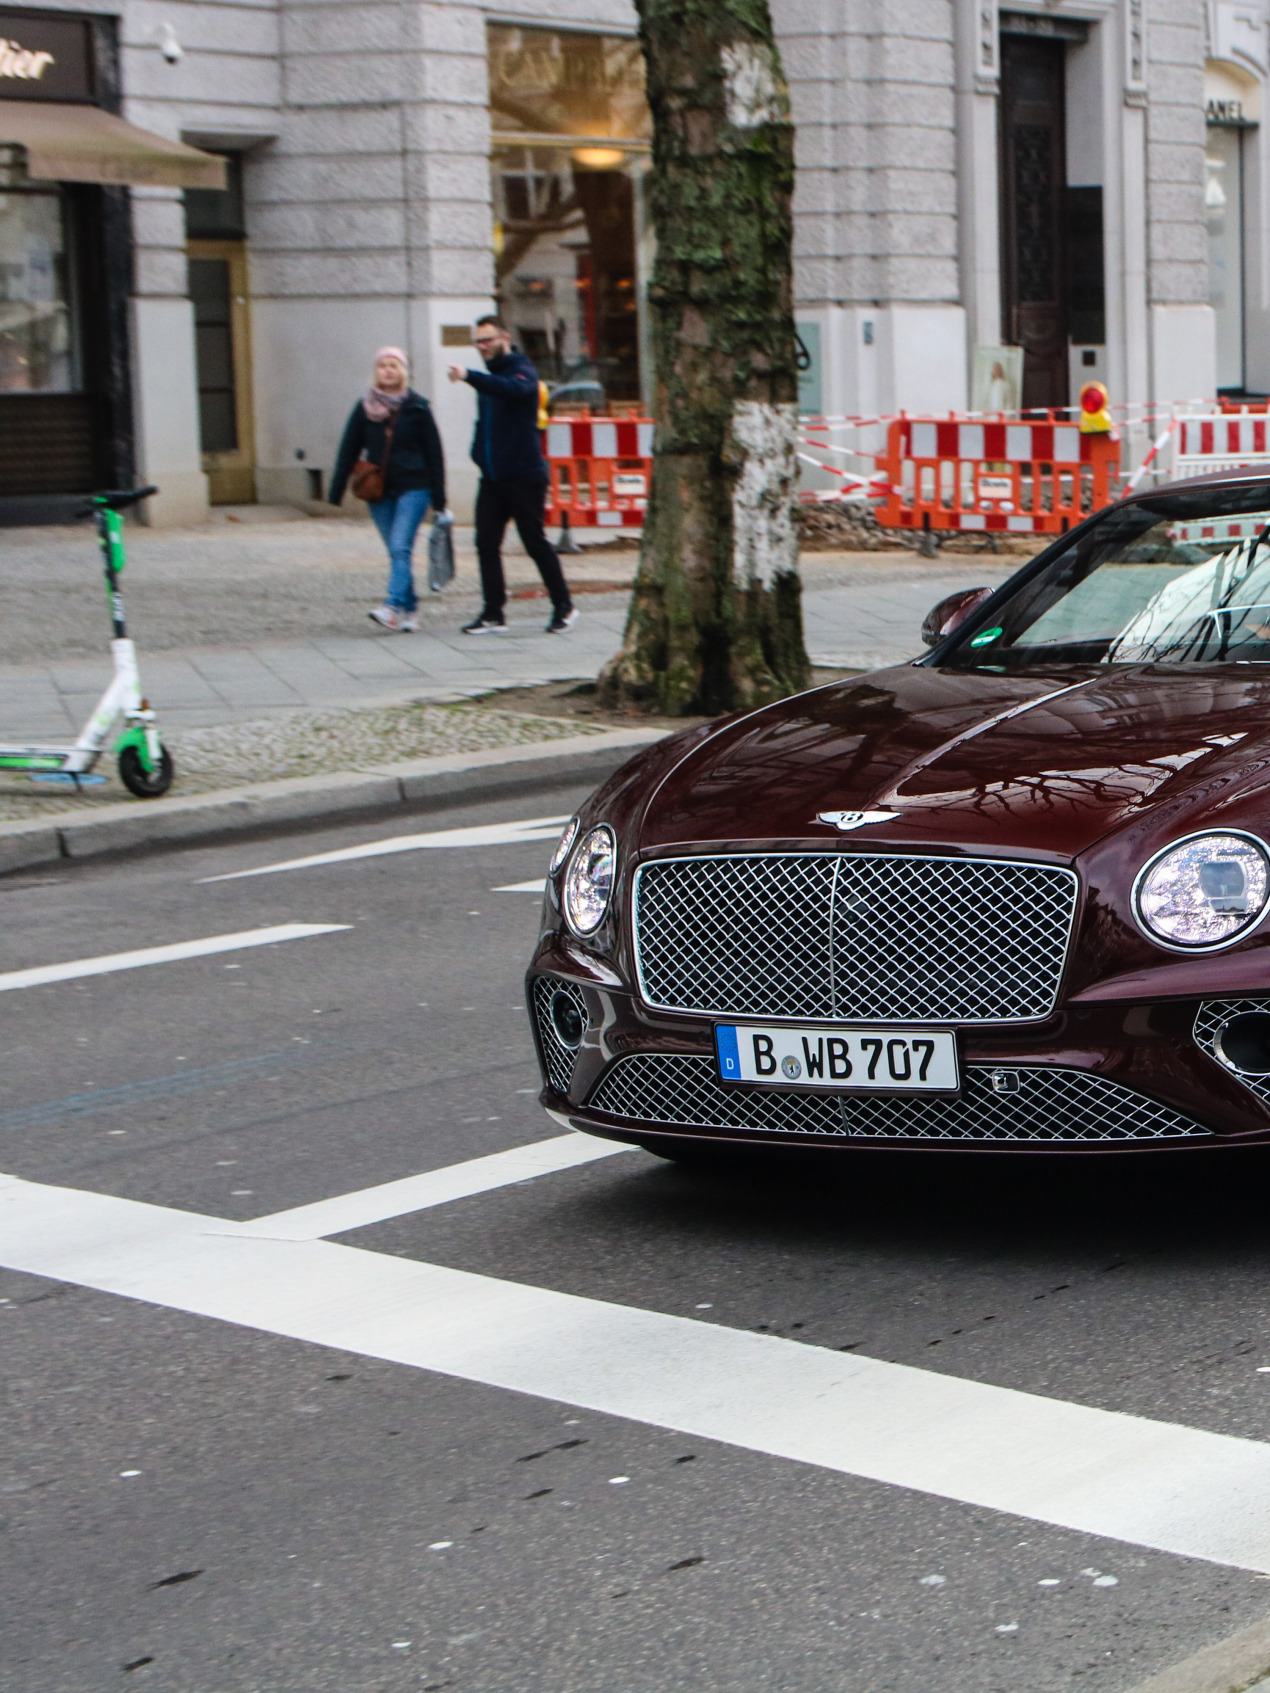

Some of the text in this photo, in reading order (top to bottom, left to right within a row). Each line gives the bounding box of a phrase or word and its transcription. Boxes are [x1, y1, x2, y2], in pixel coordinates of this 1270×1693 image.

[725, 1058, 735, 1070] D
[752, 1034, 935, 1081] B WB 707
